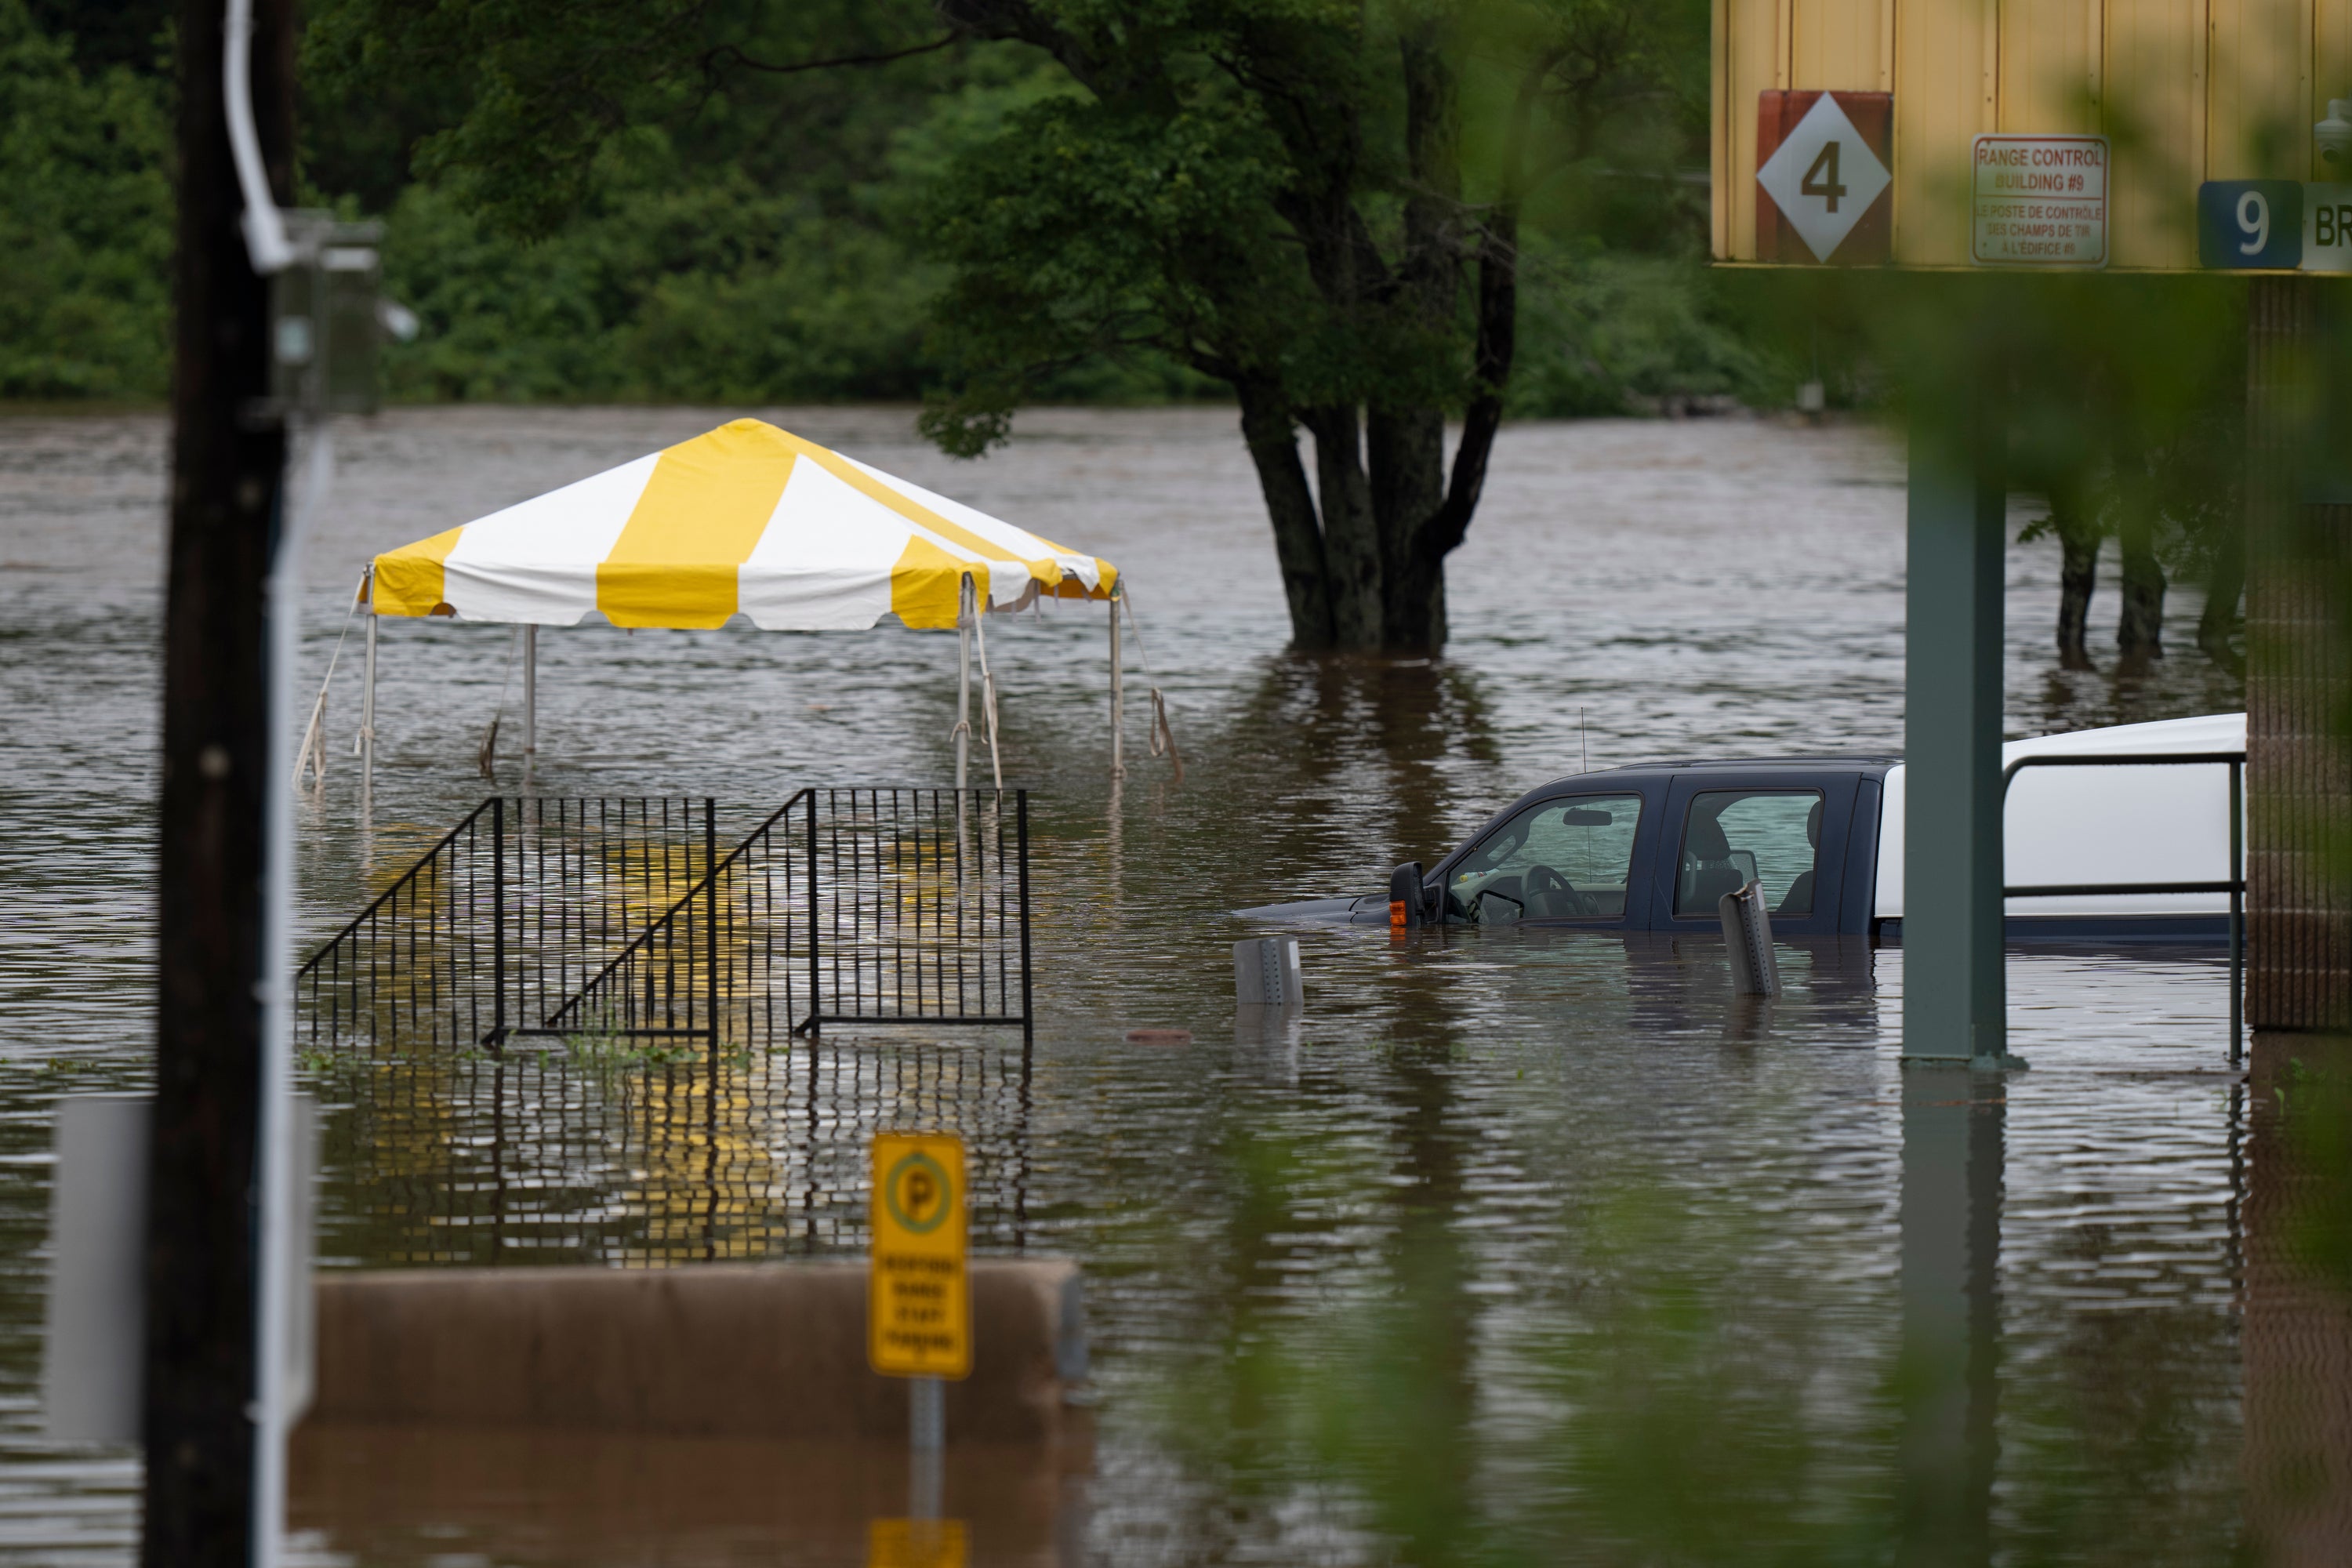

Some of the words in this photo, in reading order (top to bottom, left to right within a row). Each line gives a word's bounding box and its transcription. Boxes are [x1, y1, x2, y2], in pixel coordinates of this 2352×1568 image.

[1978, 148, 2029, 166] RANGE
[2032, 149, 2102, 167] CONTROL
[1800, 140, 1847, 214] 4
[1995, 173, 2063, 191] BUILDING
[2067, 174, 2084, 191] #9
[1991, 205, 2026, 218] POSTE
[2028, 205, 2043, 219] DE
[1987, 223, 2007, 236] DES
[2009, 224, 2055, 237] CHAMPS
[2058, 224, 2072, 237] DE
[2237, 191, 2270, 256] 9
[906, 1171, 935, 1220] P
